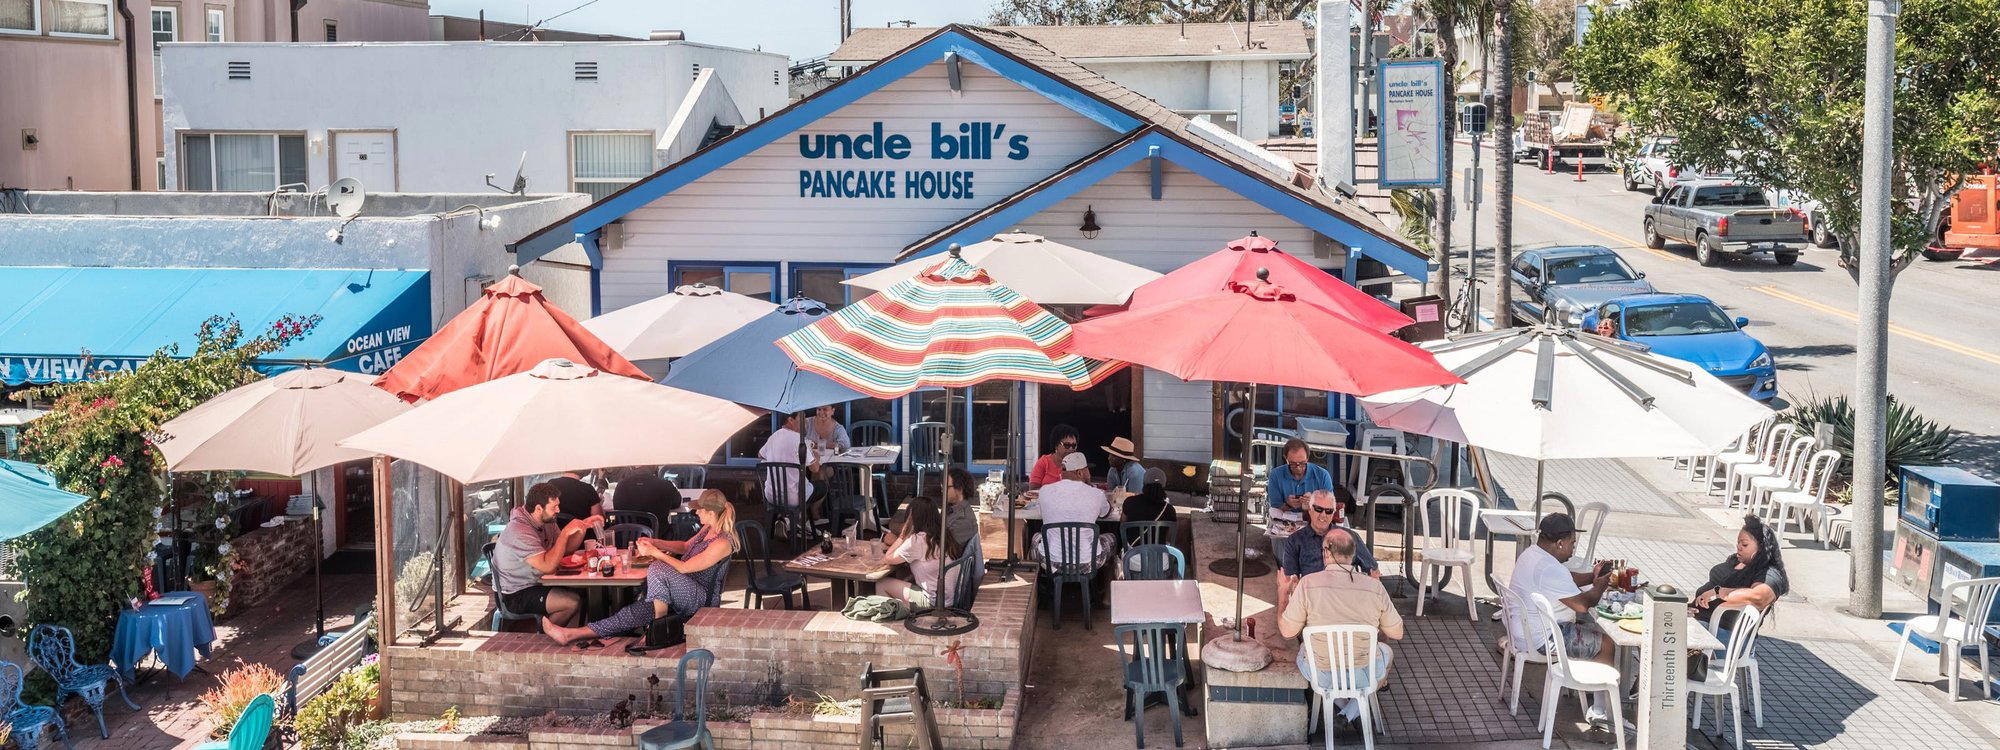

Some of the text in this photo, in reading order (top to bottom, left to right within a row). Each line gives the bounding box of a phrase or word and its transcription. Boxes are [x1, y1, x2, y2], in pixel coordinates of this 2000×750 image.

[1388, 90, 1413, 98] PANCAKE
[799, 122, 1030, 161] uncle bill's
[800, 170, 974, 199] PANCAKE HOUSE
[347, 325, 411, 353] OCEAN VIEW
[22, 358, 86, 379] VIEW
[1662, 611, 1676, 709] Thirteenth St 200
